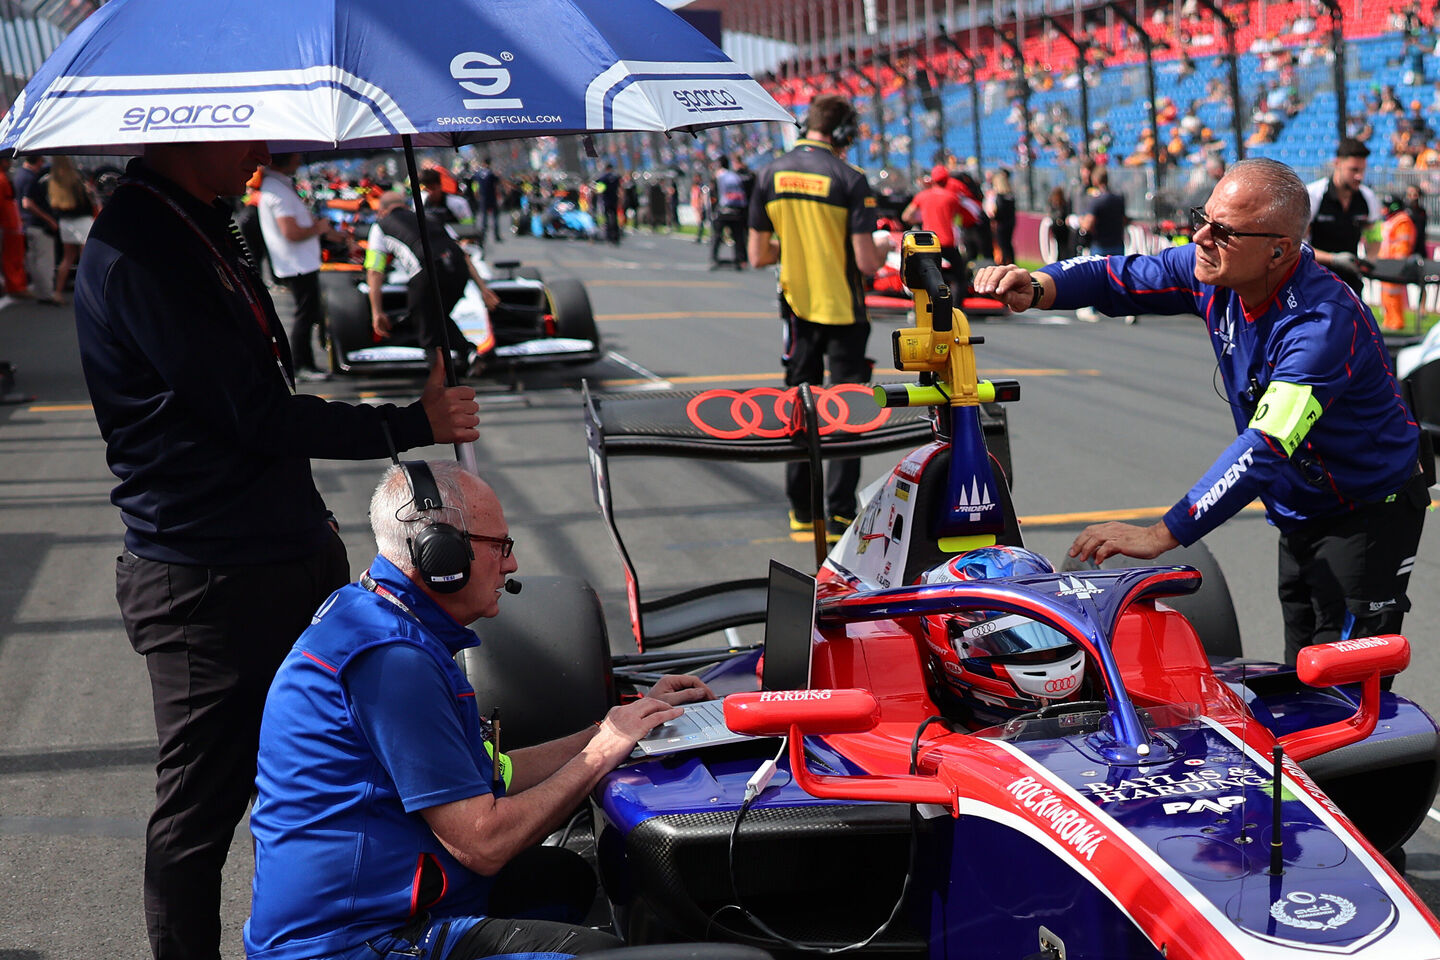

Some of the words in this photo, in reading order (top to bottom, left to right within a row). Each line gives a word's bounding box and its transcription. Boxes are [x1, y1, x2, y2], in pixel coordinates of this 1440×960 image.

[671, 87, 743, 113] sparco
[119, 103, 255, 132] sparco
[436, 115, 562, 126] SPARCO-OFFICIAL.COM
[1188, 447, 1255, 521] TRIDENT
[953, 503, 996, 513] TRIDENT
[759, 692, 832, 702] HARDING
[1084, 769, 1222, 793] BAYLIS
[1227, 766, 1257, 777] &
[1094, 775, 1268, 803] HARDING
